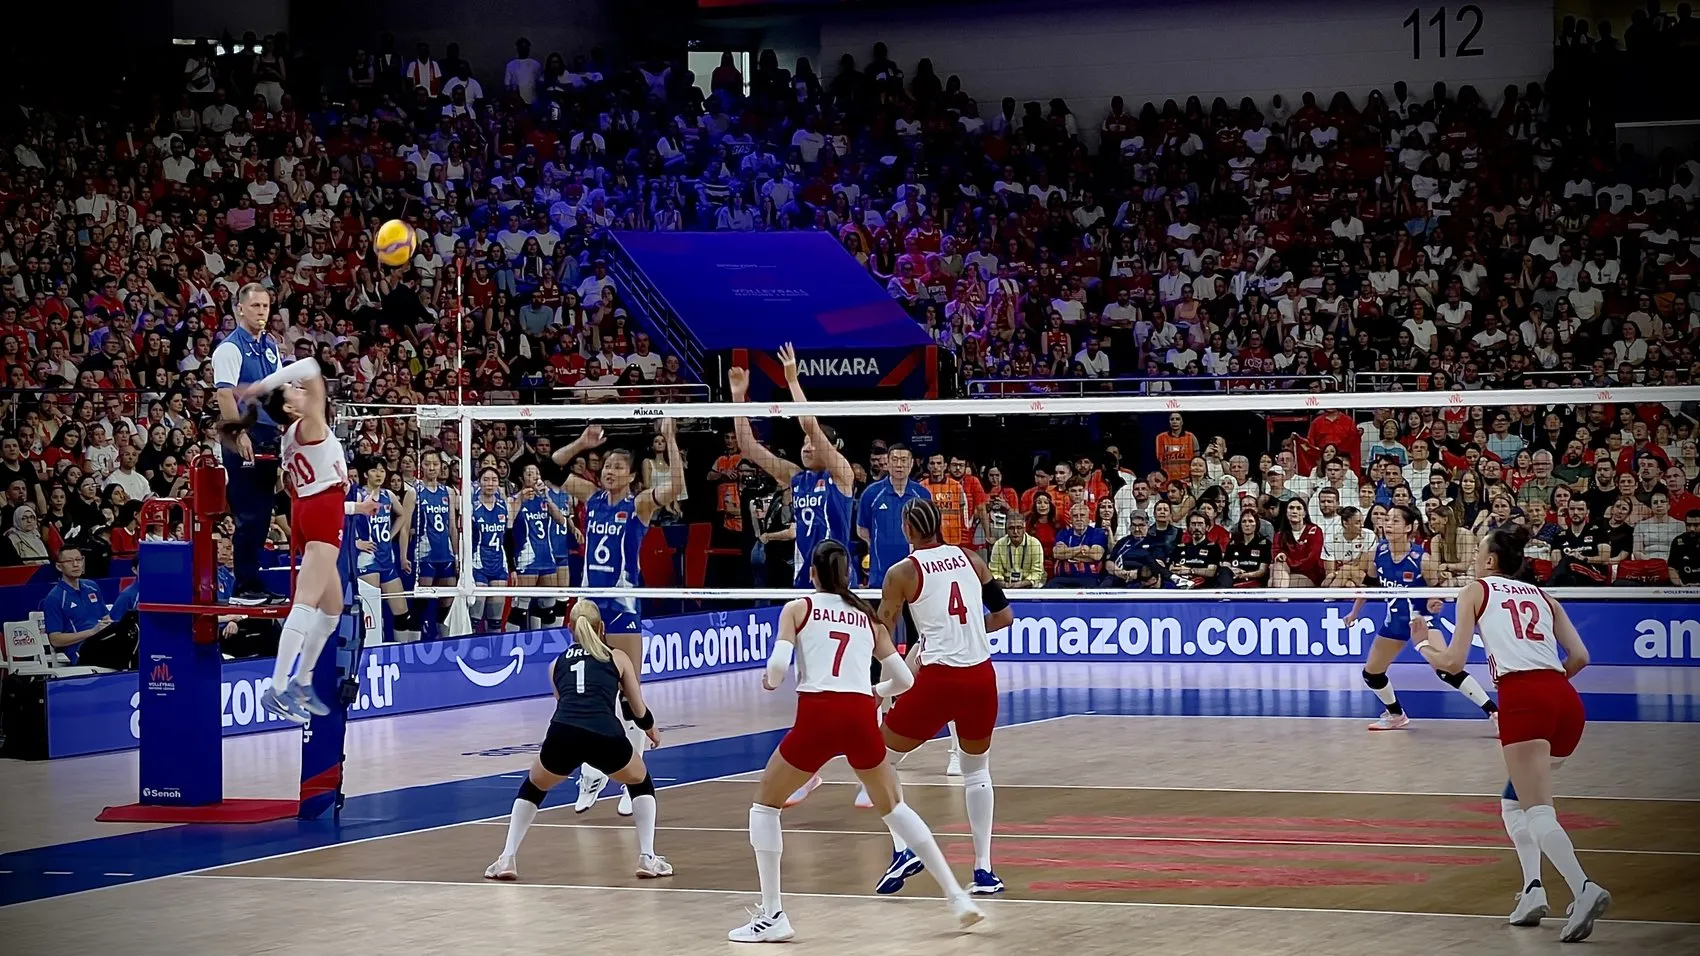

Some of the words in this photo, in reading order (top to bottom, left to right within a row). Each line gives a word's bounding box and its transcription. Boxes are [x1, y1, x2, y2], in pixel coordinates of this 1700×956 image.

[1403, 4, 1484, 60] 112
[797, 358, 880, 376] ANKARA
[426, 504, 448, 513] Haier
[793, 494, 823, 508] Haier
[434, 513, 445, 532] 8
[534, 520, 546, 539] 3
[588, 519, 623, 535] Haier
[801, 507, 815, 537] 9
[372, 523, 390, 543] 16
[488, 532, 500, 551] 4
[594, 535, 611, 564] 6
[922, 555, 967, 574] VARGAS
[948, 581, 968, 625] 4
[813, 608, 867, 629] BALADIN
[1501, 598, 1545, 641] 12
[986, 607, 1376, 656] amazon.com.tr
[641, 613, 772, 675] zon.com.tr
[829, 630, 850, 678] 7
[150, 662, 173, 681] VNL
[570, 660, 585, 694] 1
[151, 789, 181, 798] Senoh
